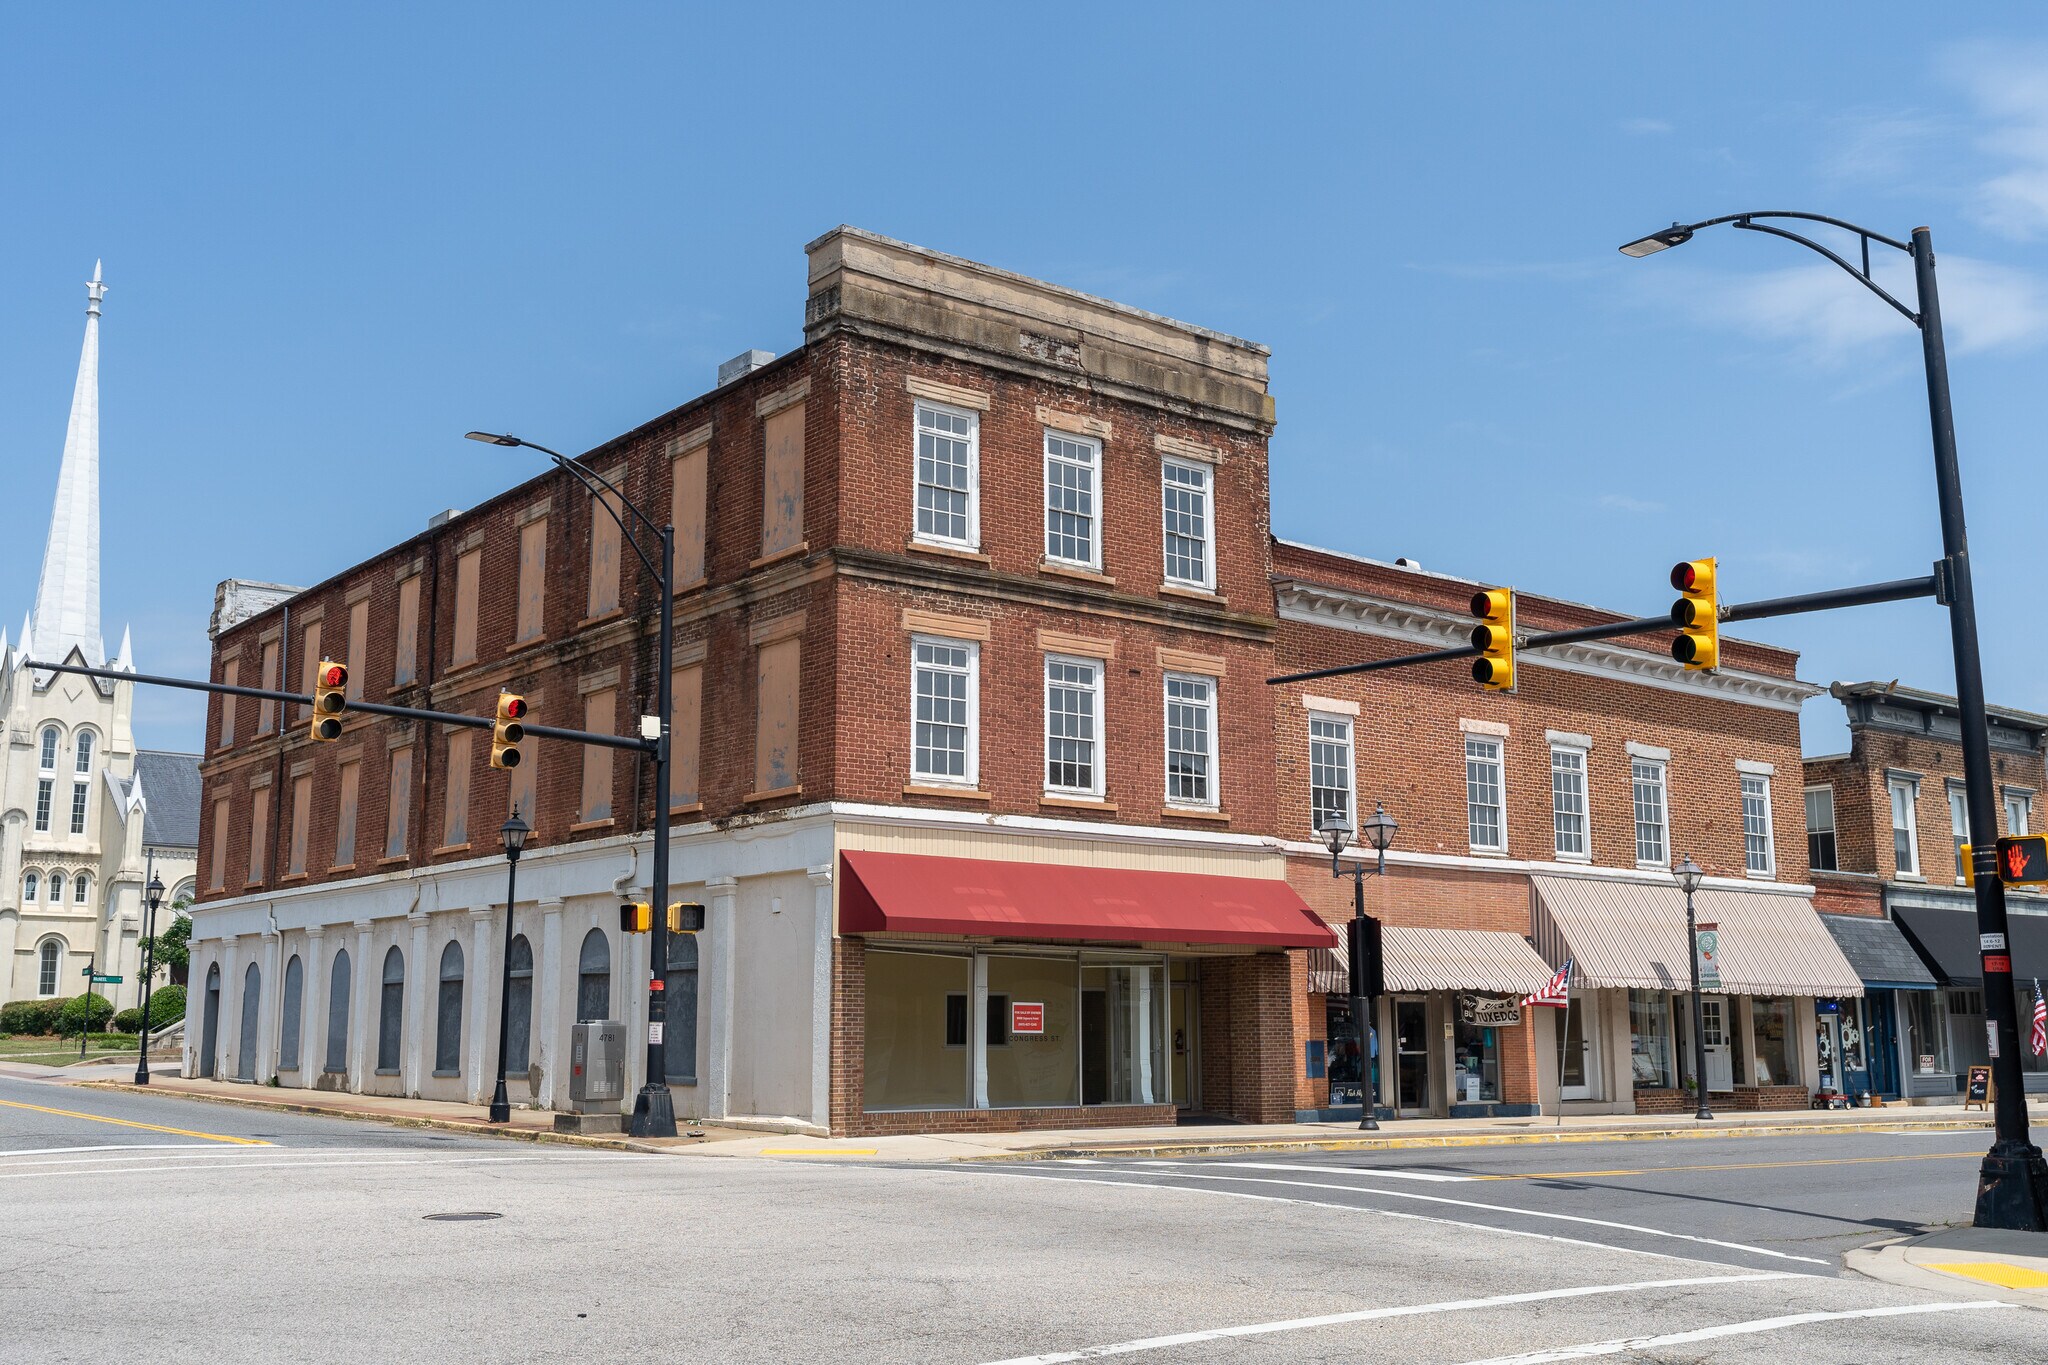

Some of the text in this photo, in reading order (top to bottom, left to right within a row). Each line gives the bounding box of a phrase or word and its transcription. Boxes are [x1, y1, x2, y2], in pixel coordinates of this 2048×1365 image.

[1507, 999, 1515, 1008] &
[1476, 1010, 1520, 1023] TUXEDOS
[599, 1033, 615, 1042] 4781
